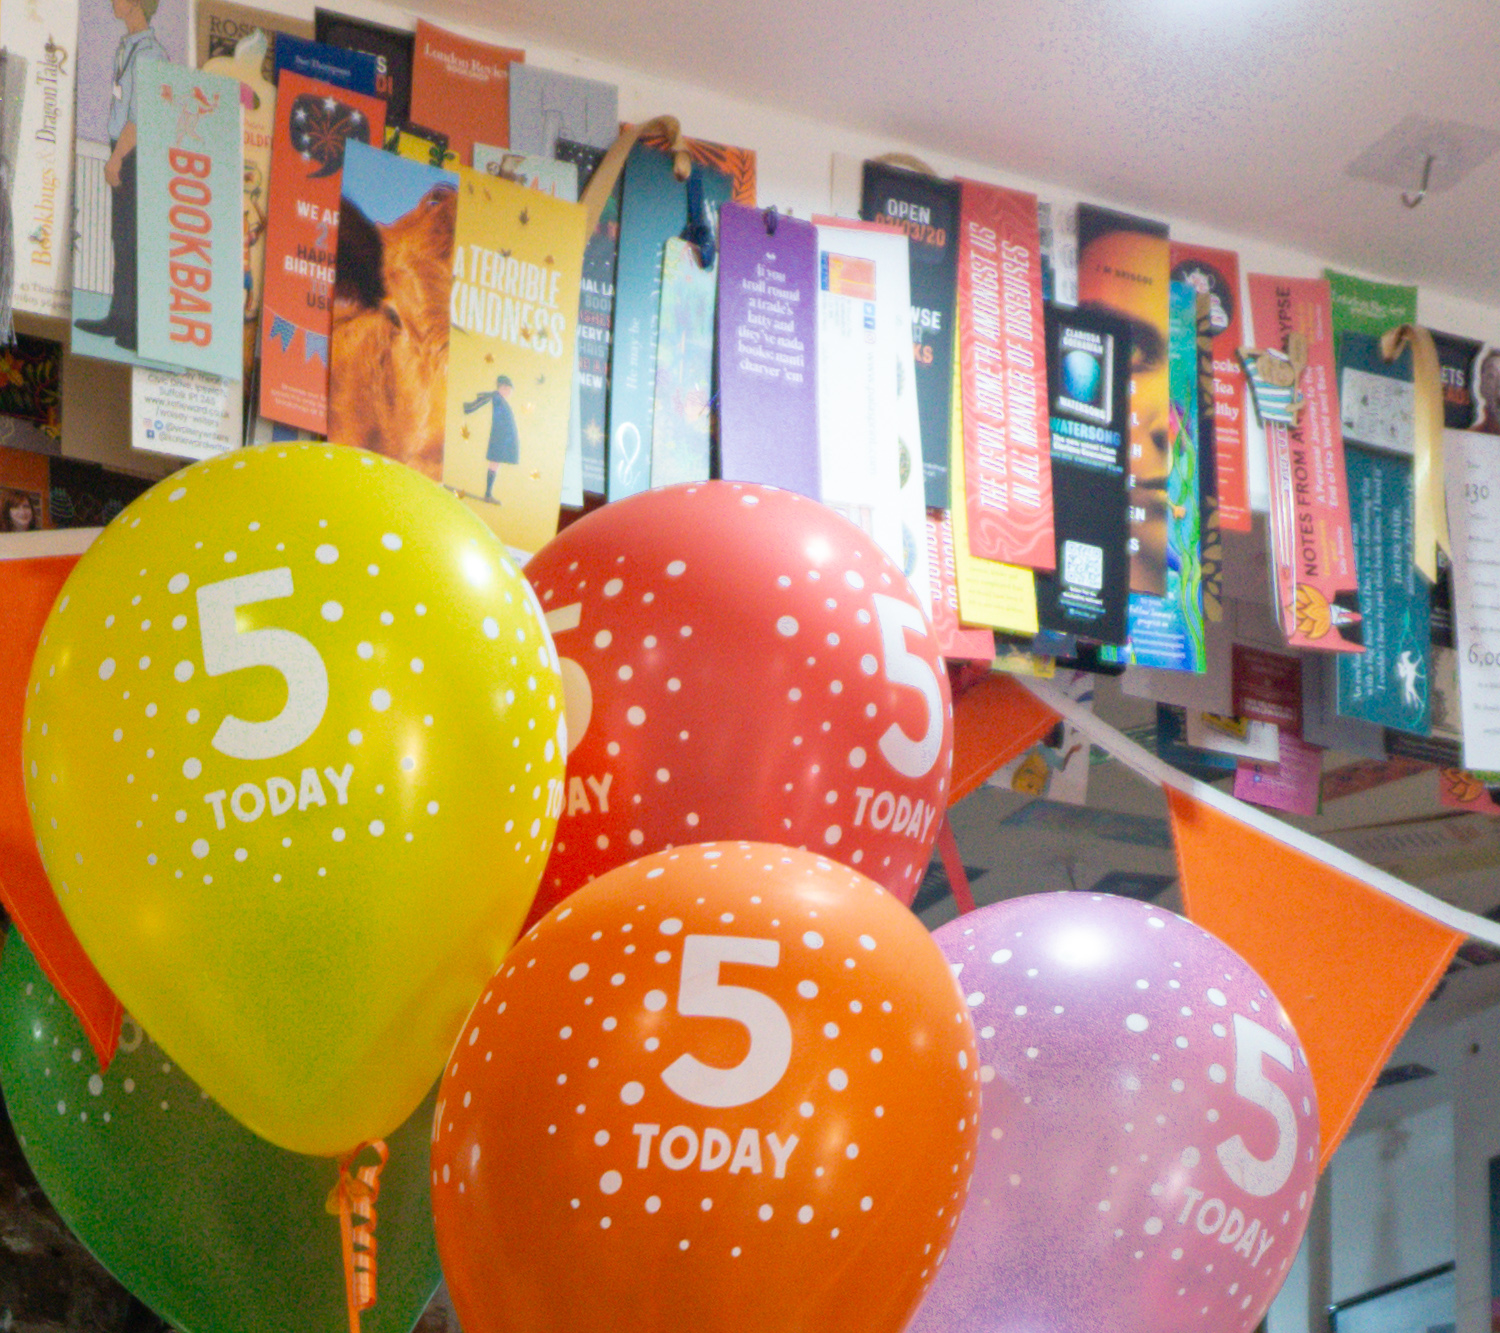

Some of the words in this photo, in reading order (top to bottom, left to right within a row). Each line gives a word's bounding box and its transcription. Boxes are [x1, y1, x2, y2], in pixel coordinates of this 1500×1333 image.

[887, 197, 931, 226] OPEN
[969, 221, 997, 251] US
[169, 146, 213, 350] BOOKBAR
[453, 245, 465, 278] A
[471, 245, 562, 309] TERRIBLE
[450, 282, 566, 358] KINDNESS
[970, 250, 1000, 344] AMONGST
[1001, 239, 1034, 342] DISGUISES
[975, 344, 1005, 419] COMETH
[1006, 340, 1035, 369] OF
[1006, 367, 1038, 449] MANNER
[1050, 417, 1121, 445] WATERSONG
[977, 421, 1008, 475] DEVIL
[1012, 449, 1040, 483] ALL
[1296, 450, 1313, 505] FROM
[980, 476, 1009, 513] THE
[1012, 484, 1041, 509] IN
[1299, 515, 1317, 577] NOTES
[196, 565, 331, 762] 5
[872, 594, 945, 778] 5
[204, 761, 354, 832] TODAY
[854, 785, 936, 842] TODAY
[659, 934, 794, 1110] 5
[1215, 1013, 1299, 1198] 5
[632, 1122, 800, 1180] TODAY
[1177, 1187, 1276, 1270] TODAY
